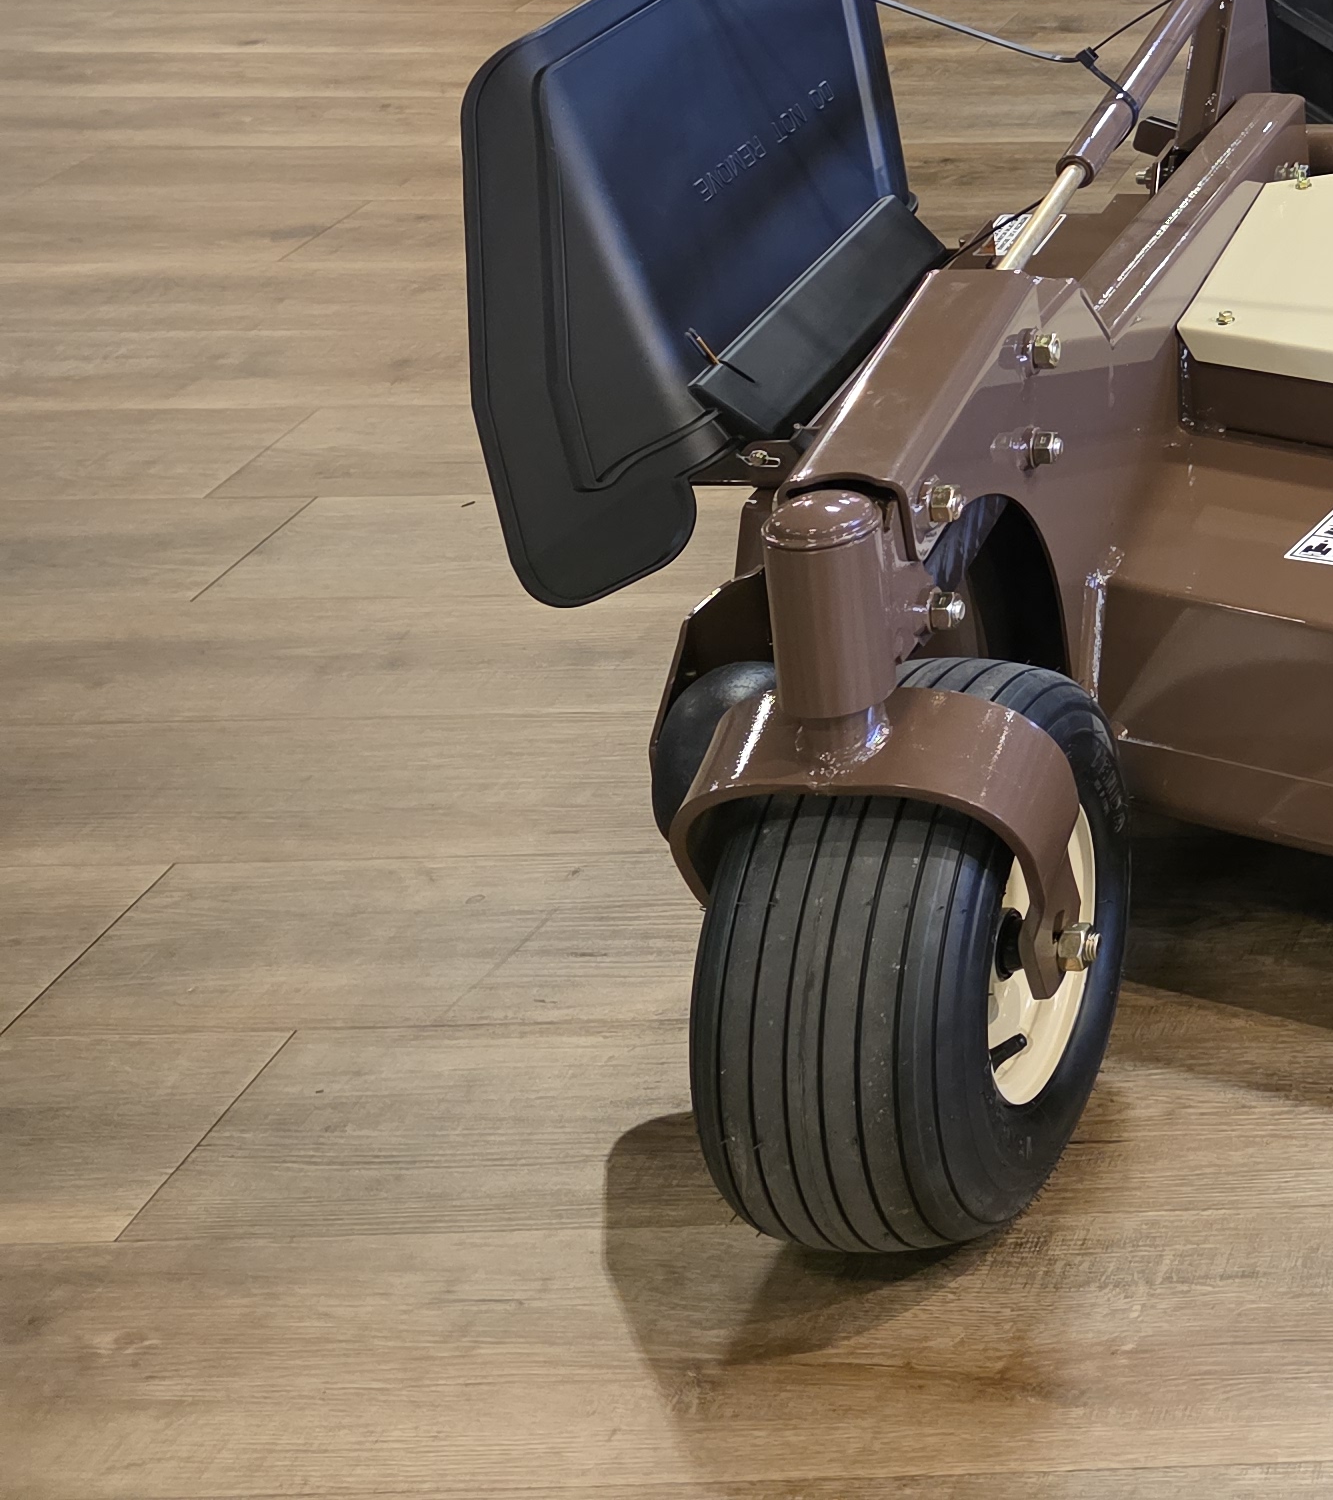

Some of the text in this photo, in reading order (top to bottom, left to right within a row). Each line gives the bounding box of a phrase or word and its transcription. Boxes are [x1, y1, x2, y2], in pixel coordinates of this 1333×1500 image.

[693, 80, 835, 202] DO NOT REMOVE
